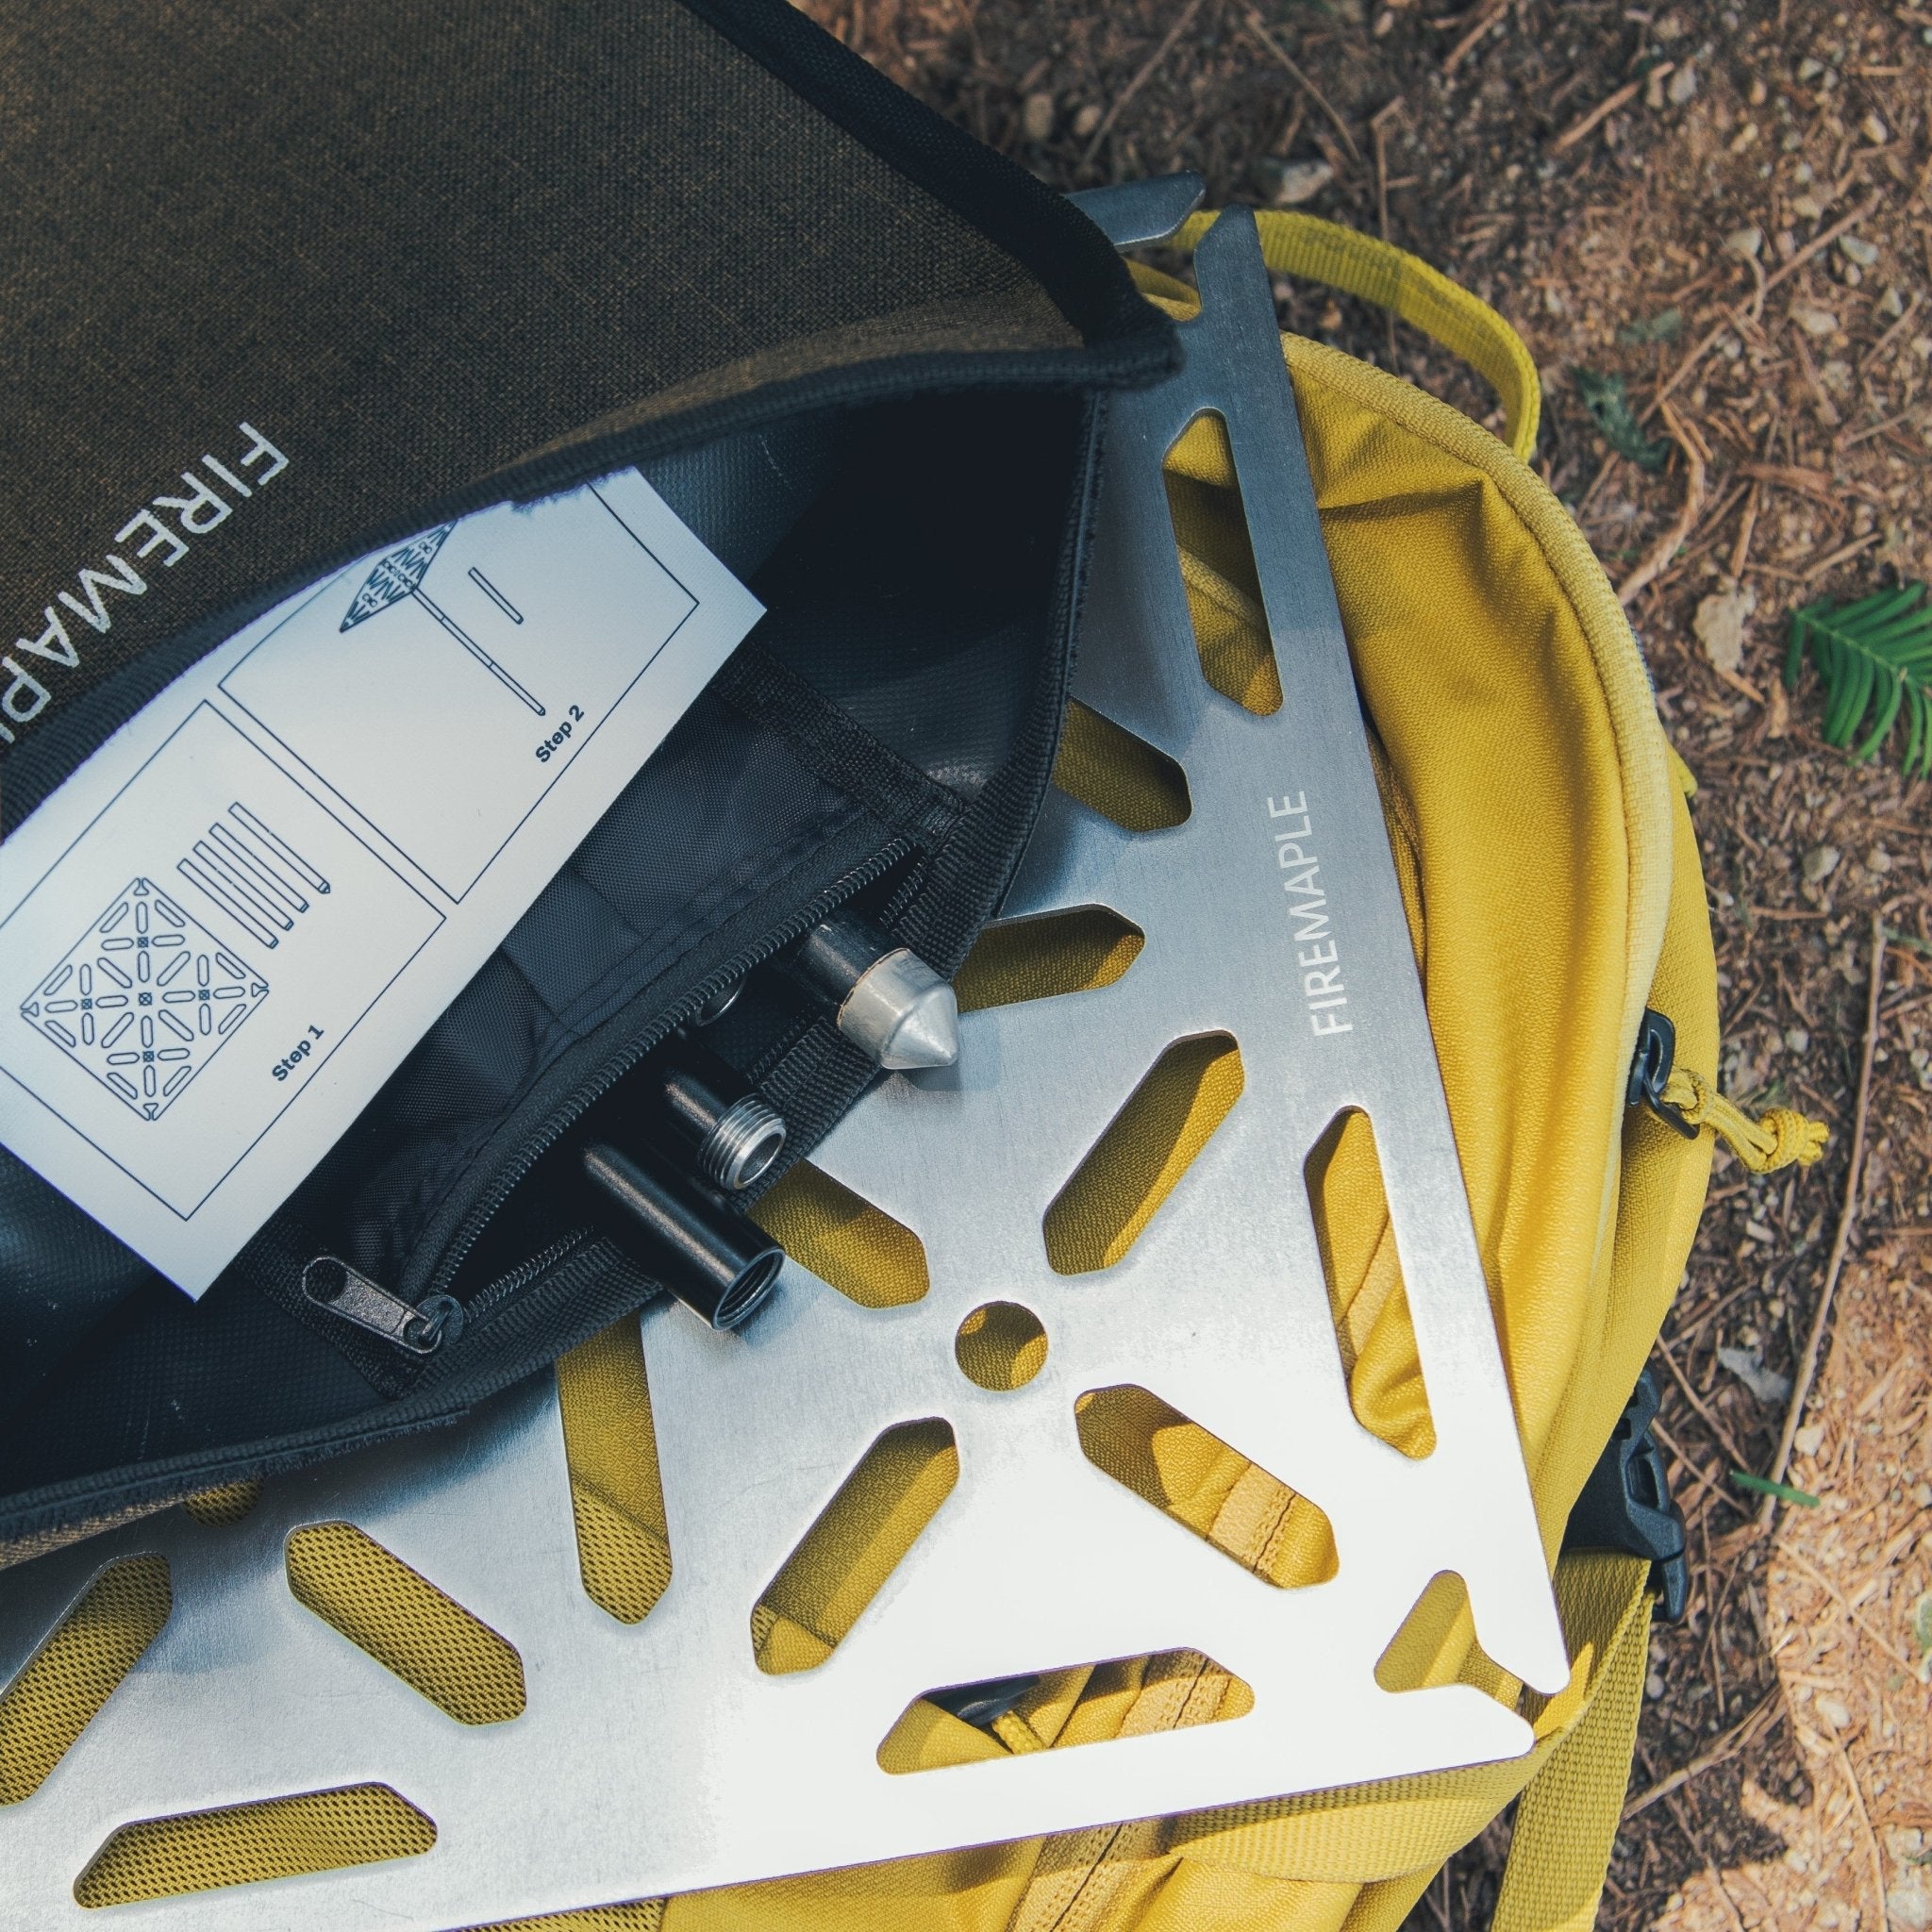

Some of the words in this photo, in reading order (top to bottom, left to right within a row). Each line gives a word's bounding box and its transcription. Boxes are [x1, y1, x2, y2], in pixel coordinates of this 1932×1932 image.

[0, 422, 289, 743] FIREMAP
[536, 722, 572, 762] Step
[569, 705, 585, 722] 2
[1267, 791, 1353, 1037] FIREMAPLE
[272, 1041, 311, 1081] Step
[308, 1024, 325, 1040] 1
